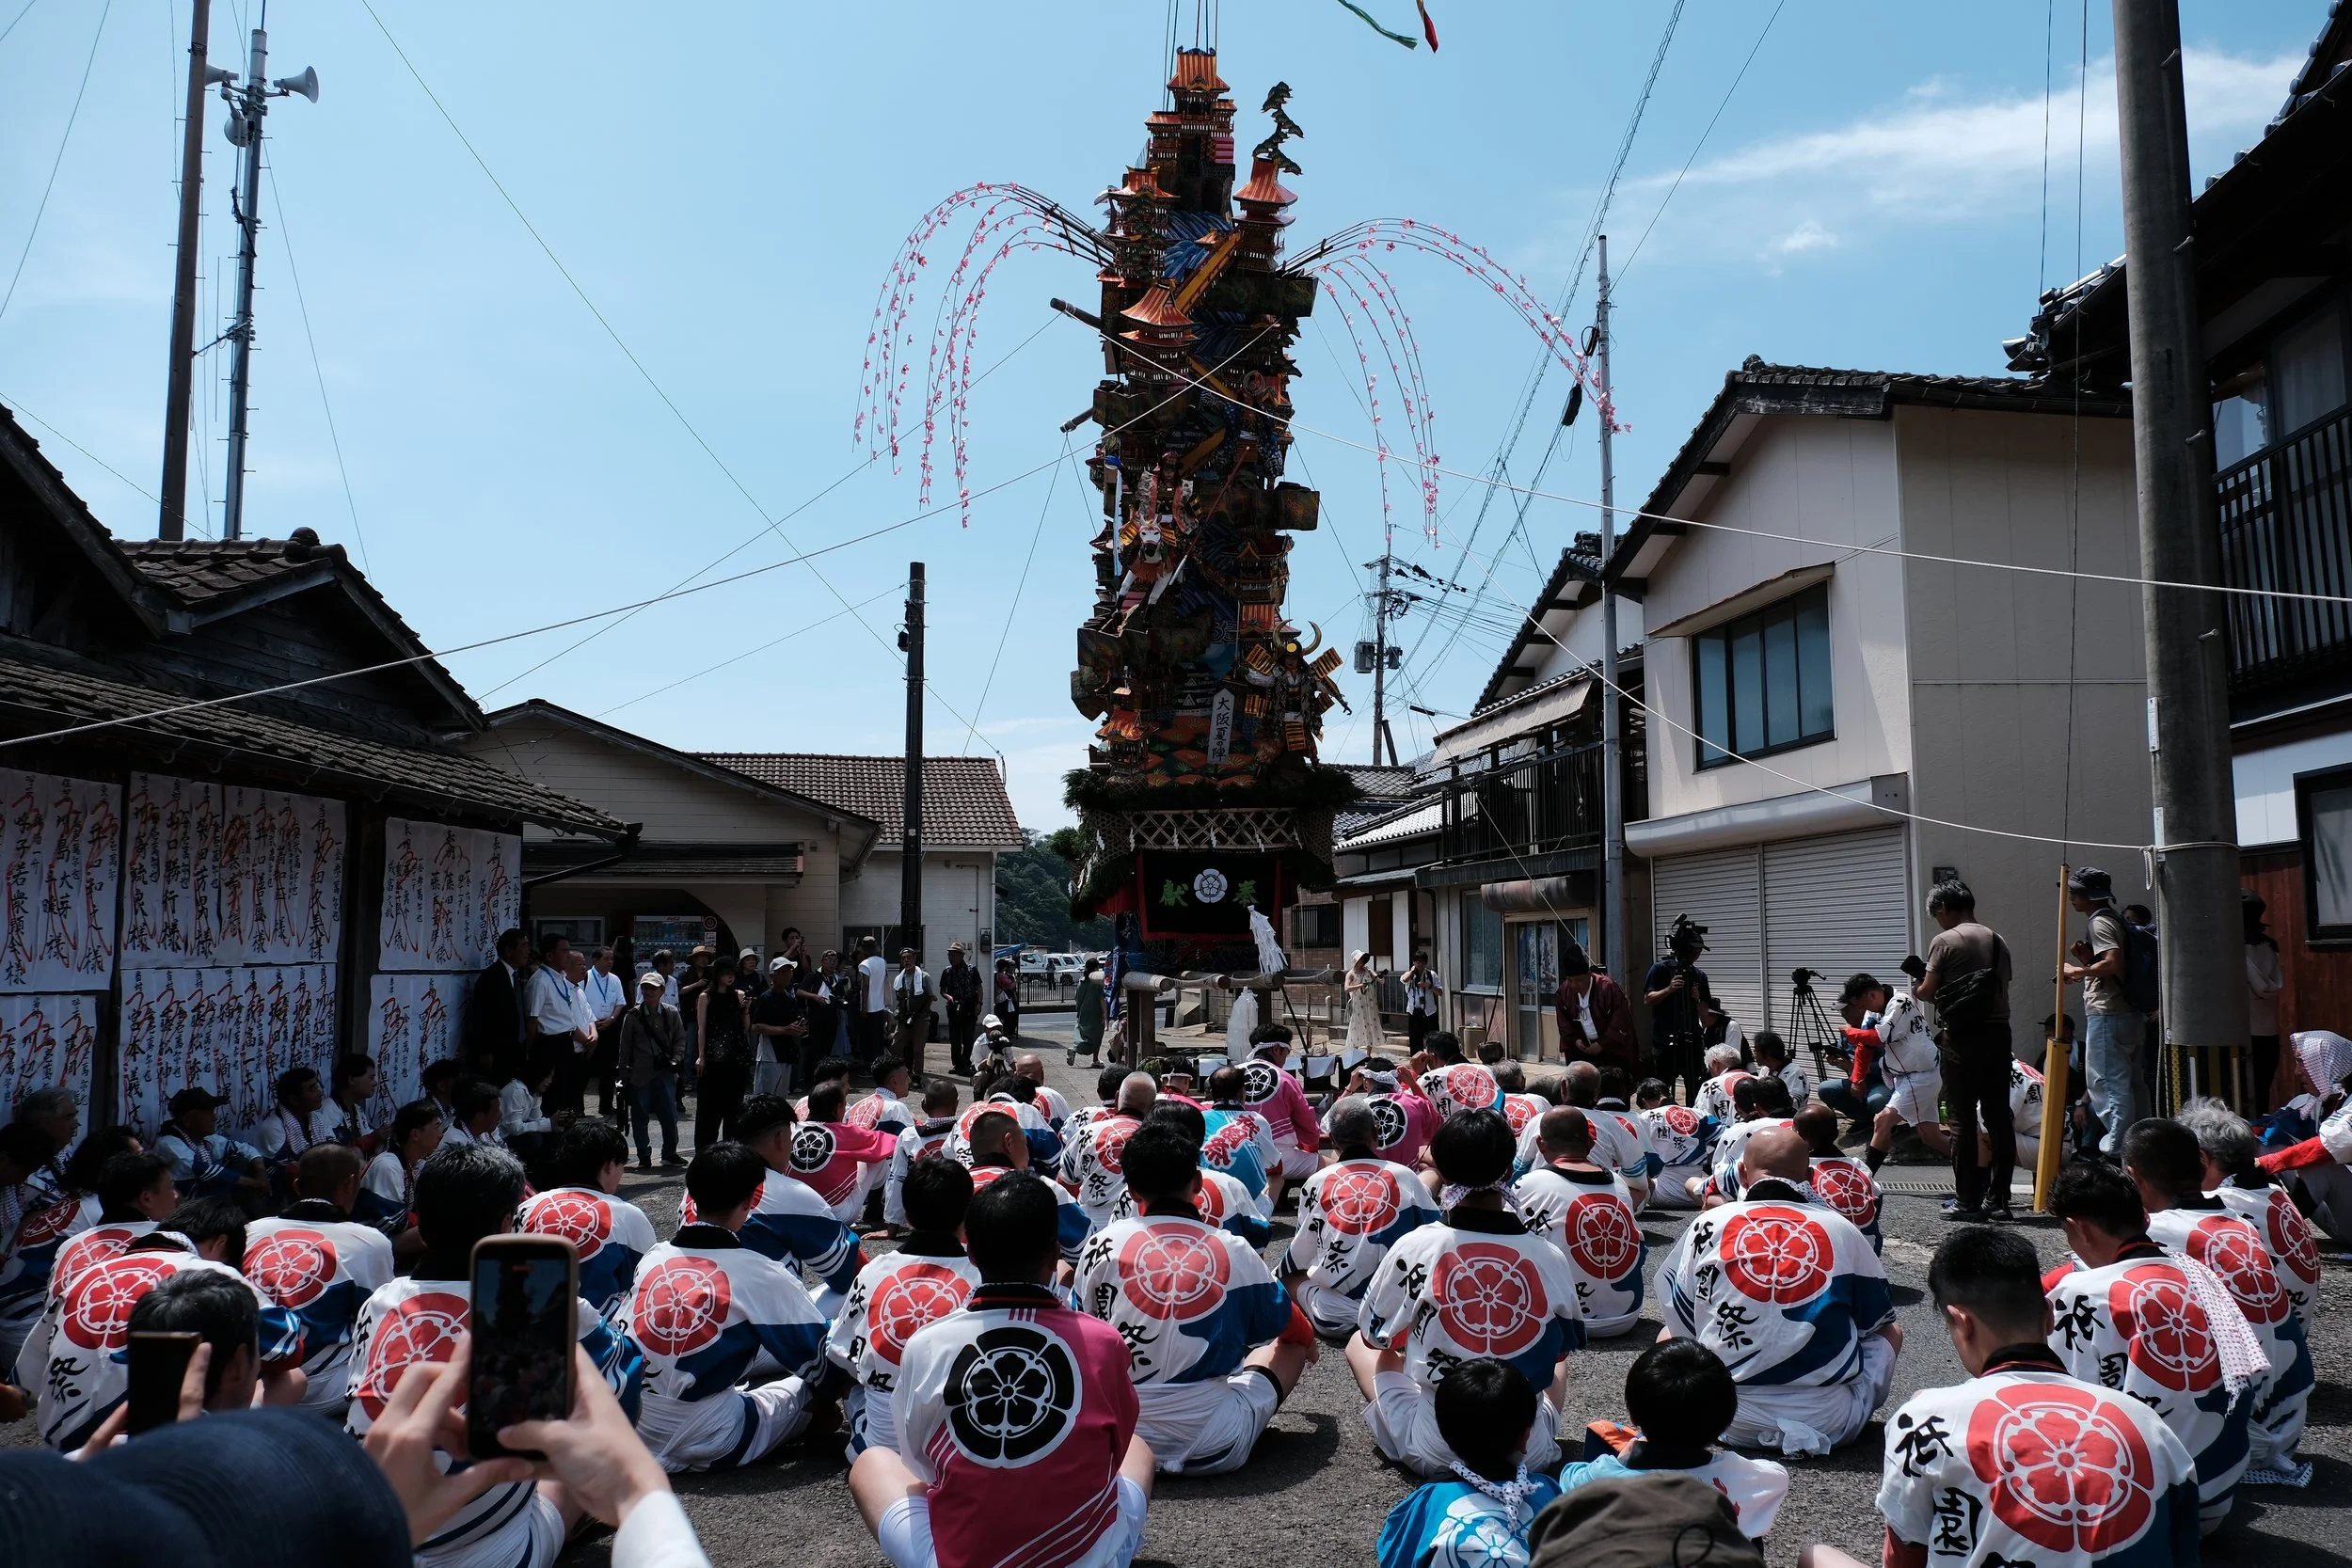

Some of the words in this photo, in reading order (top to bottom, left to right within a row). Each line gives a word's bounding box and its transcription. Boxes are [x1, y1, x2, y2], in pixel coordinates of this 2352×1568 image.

[1213, 697, 1231, 762] 大阪夏の陣
